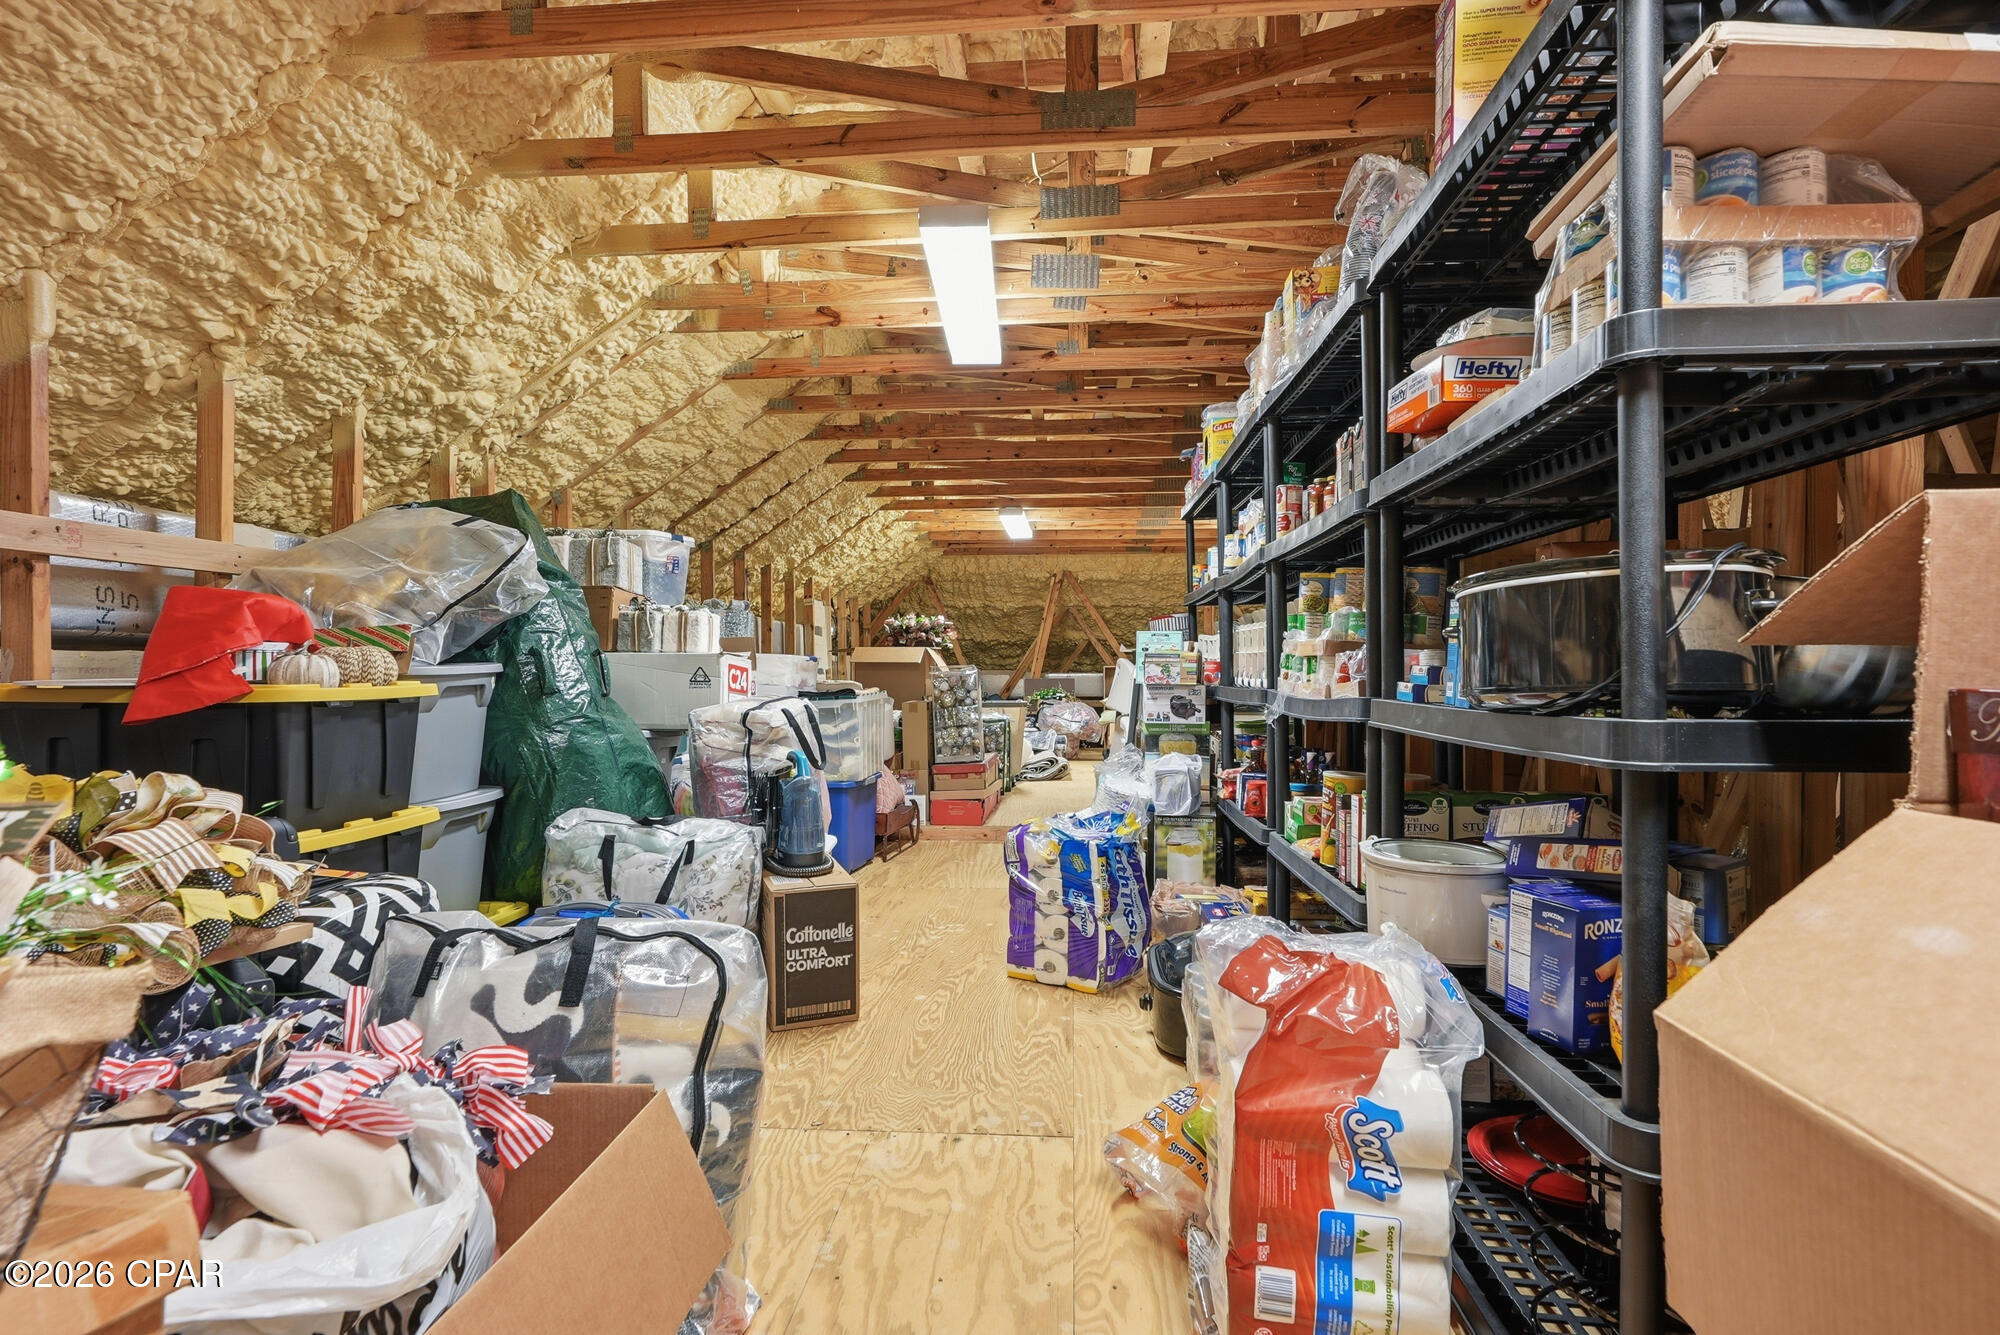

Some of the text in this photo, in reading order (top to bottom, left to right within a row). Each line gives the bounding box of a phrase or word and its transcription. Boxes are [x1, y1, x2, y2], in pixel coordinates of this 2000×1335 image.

[1711, 166, 1742, 179] sliced
[1460, 361, 1517, 378] Hefty
[1453, 384, 1473, 393] 360
[728, 667, 748, 692] C24
[786, 922, 854, 944] Cottonelle
[1584, 918, 1622, 940] RONZ
[786, 946, 828, 960] ULTRA
[786, 955, 851, 972] COMFORT
[1170, 1092, 1199, 1108] 200
[1168, 1142, 1197, 1165] Strong
[1347, 1111, 1402, 1189] Scott
[1384, 1253, 1394, 1318] Sustainability
